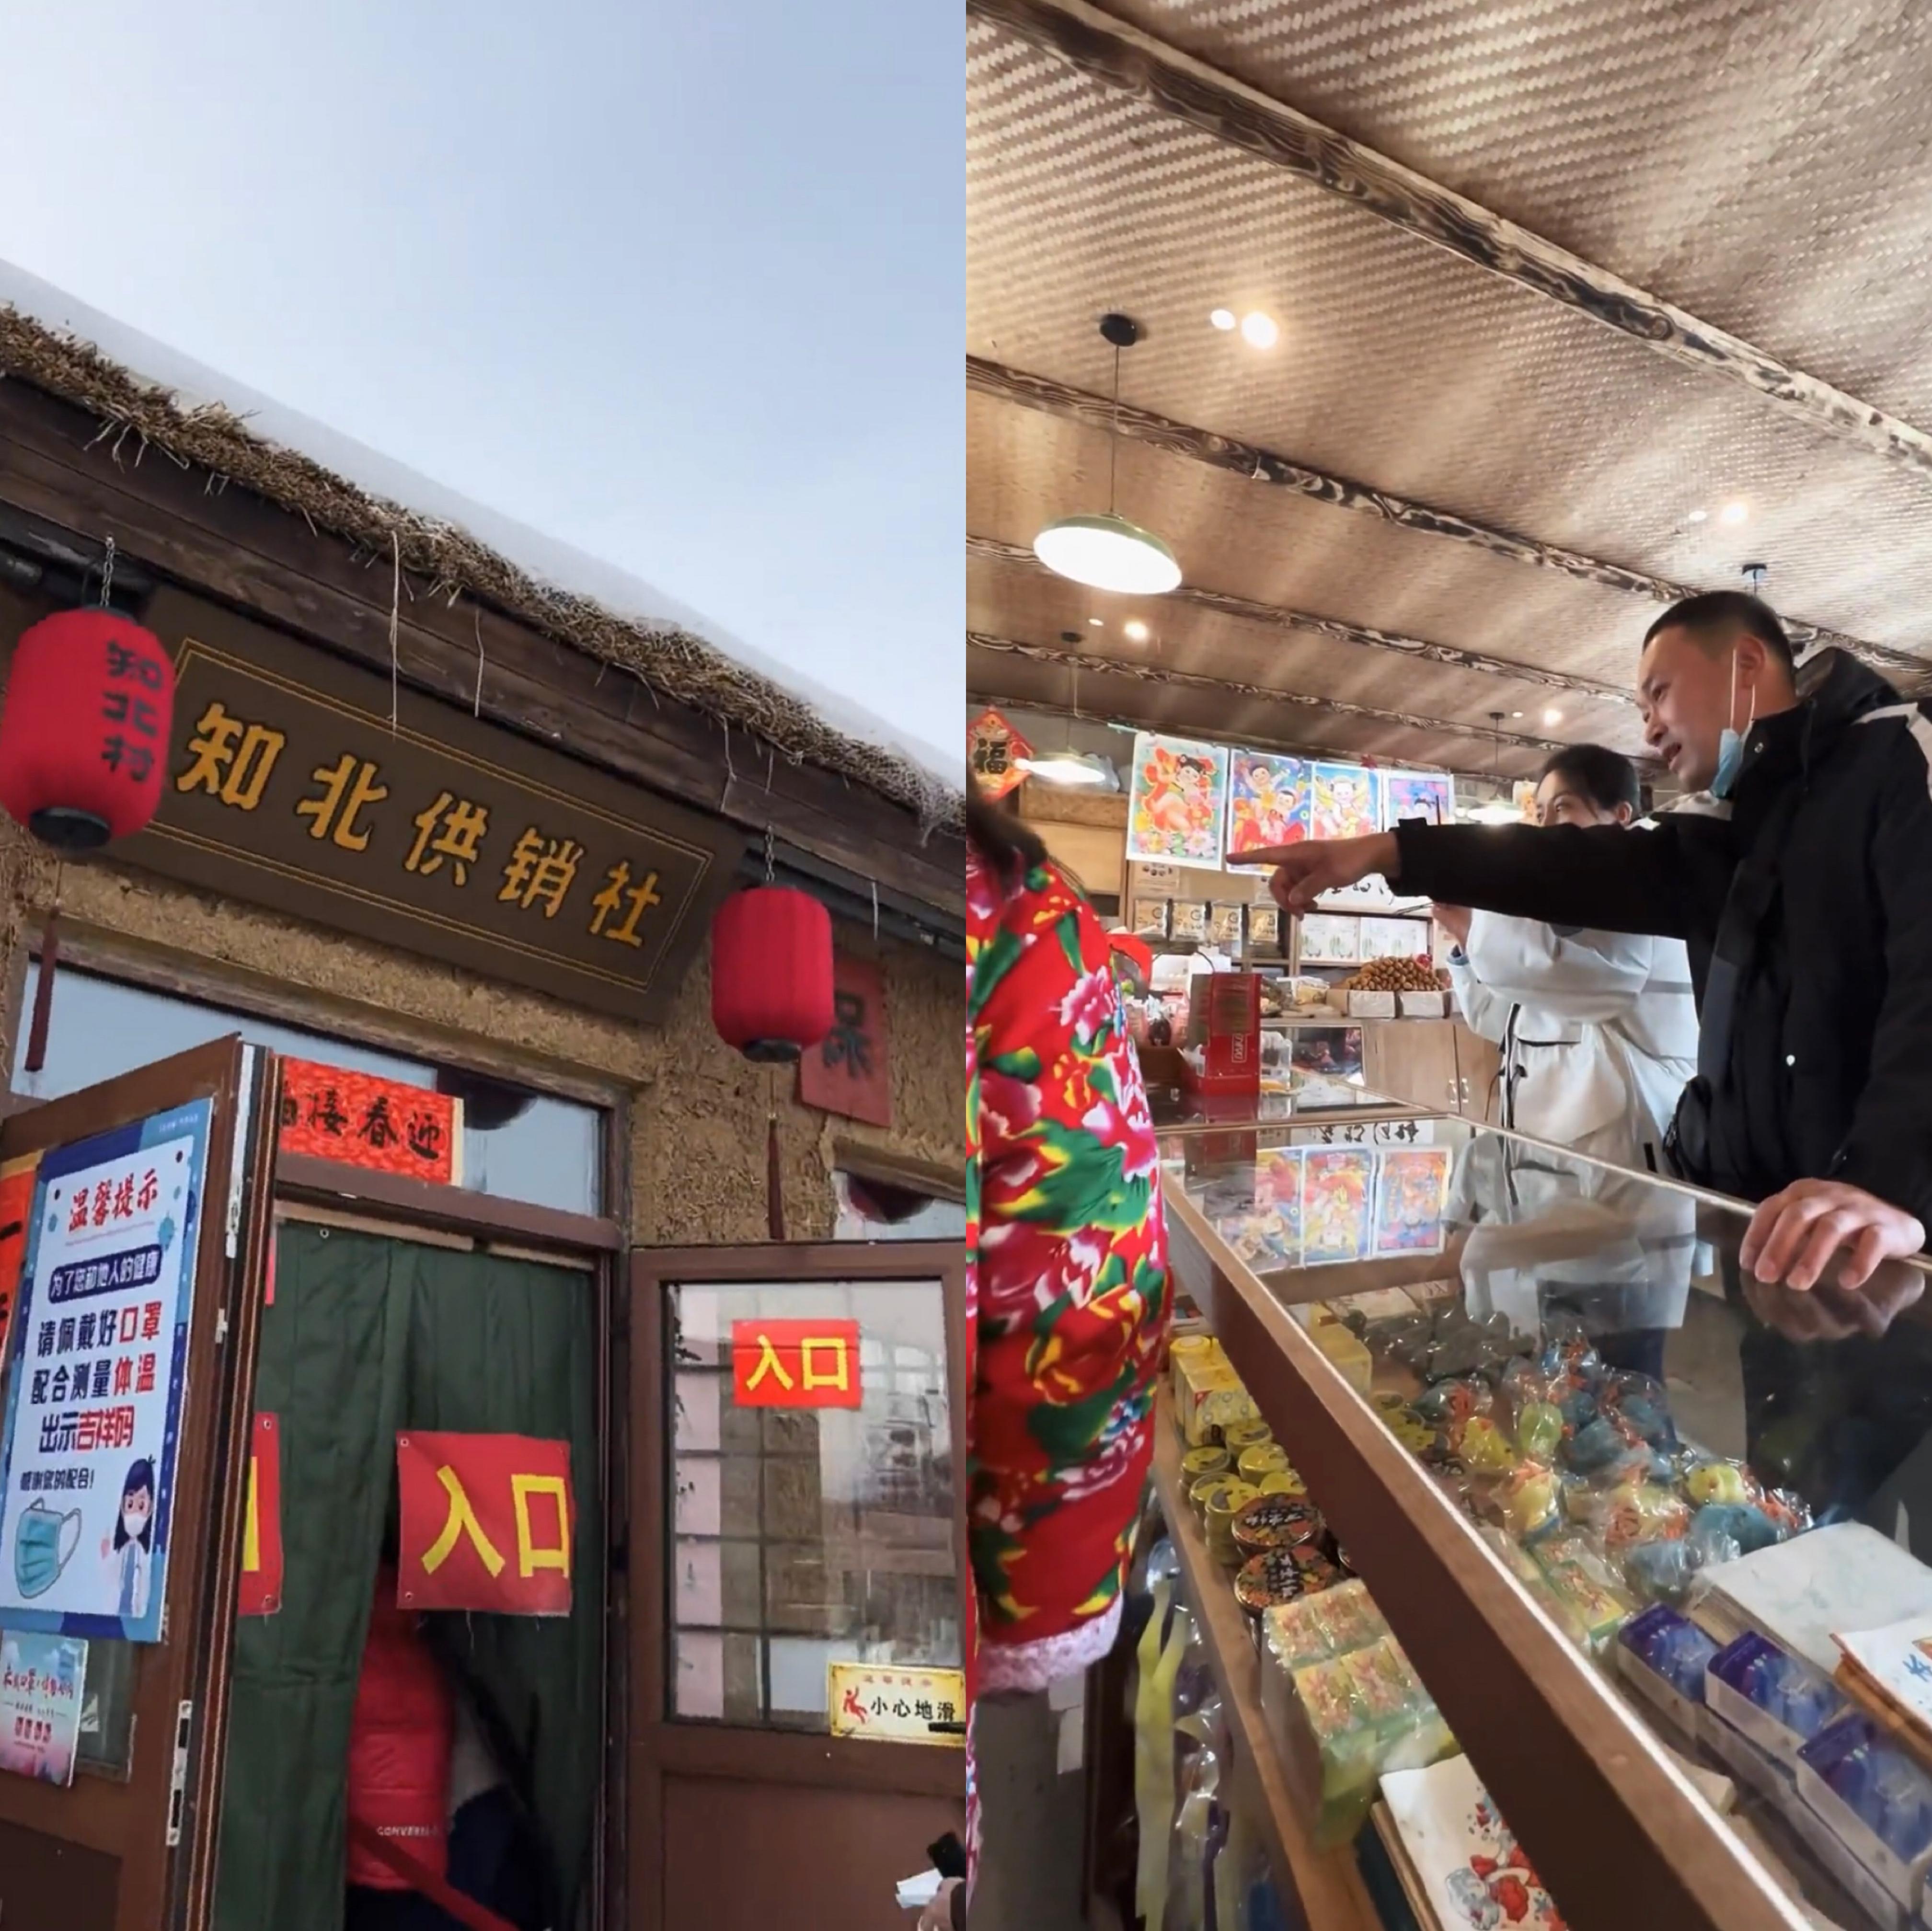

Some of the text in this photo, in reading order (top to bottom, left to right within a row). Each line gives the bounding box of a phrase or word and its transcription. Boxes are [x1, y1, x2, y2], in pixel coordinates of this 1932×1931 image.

[177, 702, 661, 947] 知北供销社
[69, 1168, 158, 1231] 温馨提示
[51, 1251, 158, 1297] 为了您和他人的健康
[37, 1301, 162, 1357] 请佩戴好口罩
[31, 1353, 156, 1404] 配合测量体温
[747, 1334, 848, 1391] 入口
[39, 1406, 134, 1453] 出示吉祥码
[421, 1465, 569, 1578] 入口
[871, 1696, 955, 1722] 小心地滑
